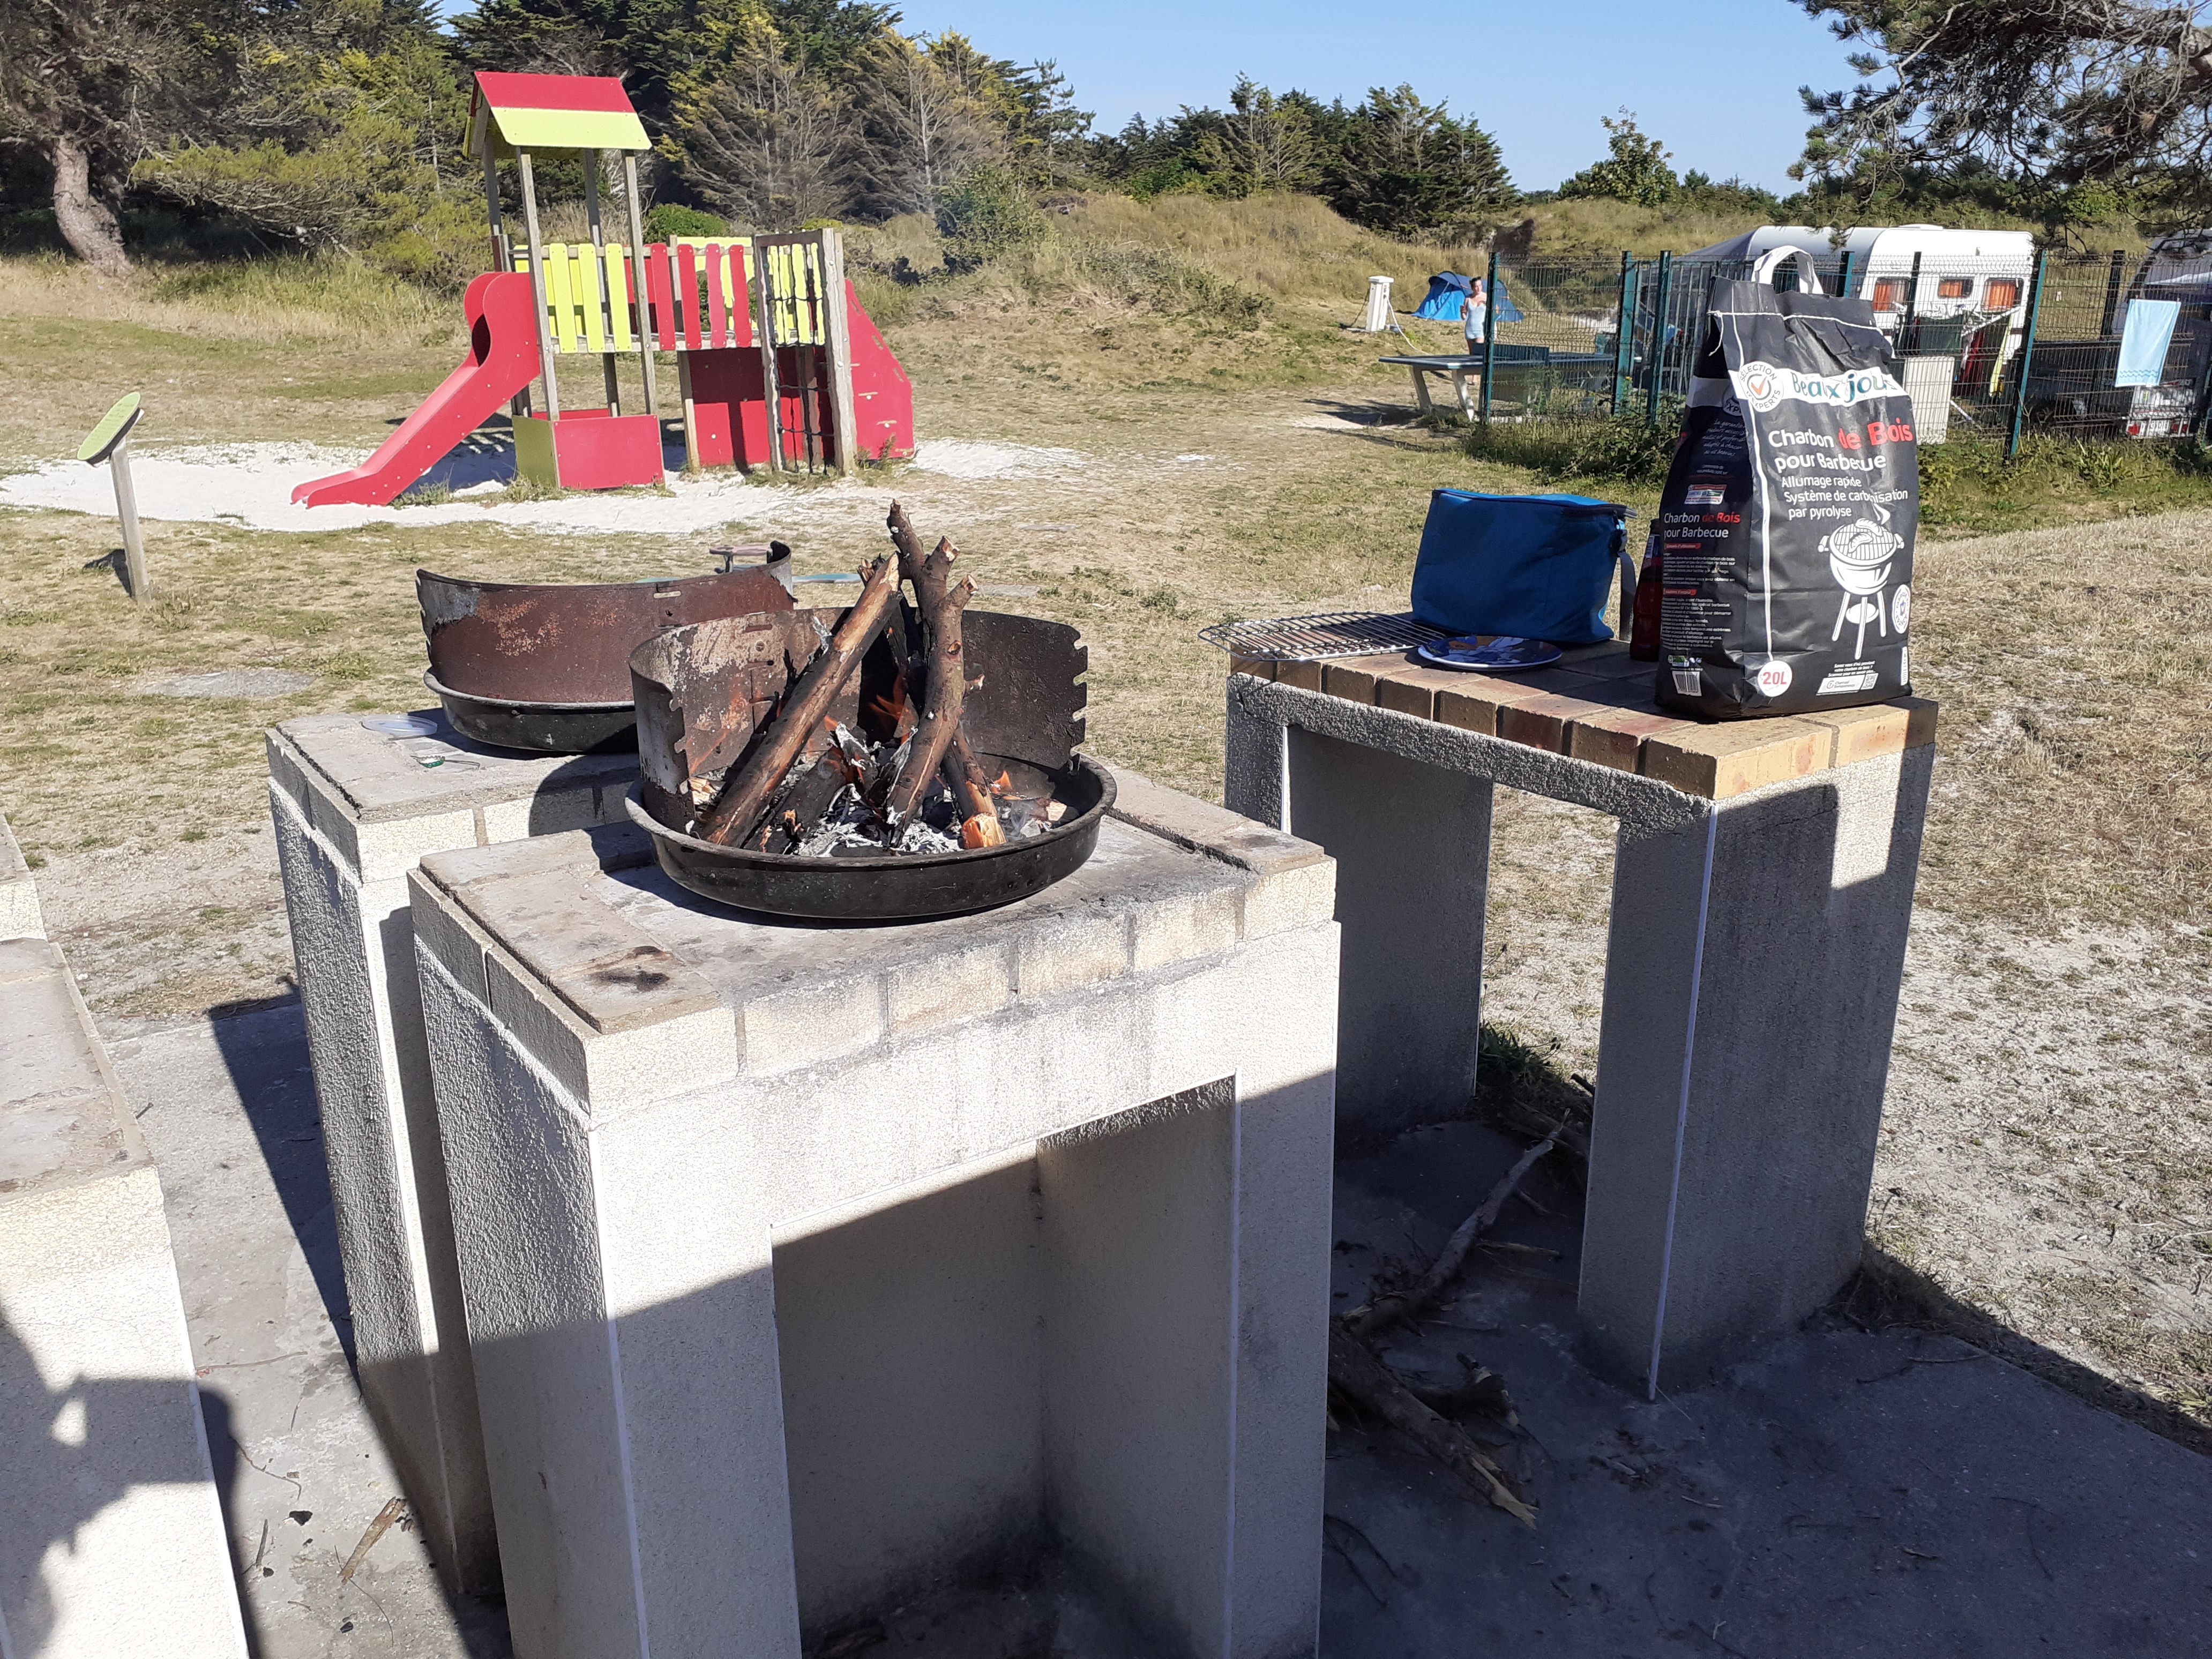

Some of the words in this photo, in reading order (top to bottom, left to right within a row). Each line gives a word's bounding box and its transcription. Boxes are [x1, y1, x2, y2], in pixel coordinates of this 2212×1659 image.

[1768, 429, 1835, 447] Charbon
[1838, 428, 1861, 450] de
[1867, 417, 1914, 446] Bois
[1774, 454, 1815, 473] pour
[1816, 453, 1886, 472] Barbecue
[1781, 476, 1832, 488] Allumage
[1833, 476, 1862, 488] rapide
[1784, 490, 1832, 505] Système
[1834, 490, 1847, 501] de
[1664, 512, 1700, 524] Charbon
[1702, 513, 1714, 522] de
[1716, 511, 1741, 524] Bois
[1788, 508, 1807, 521] par
[1810, 505, 1852, 519] pyrolyse
[1682, 527, 1729, 538] Barbecue
[1762, 671, 1787, 685] 20L
